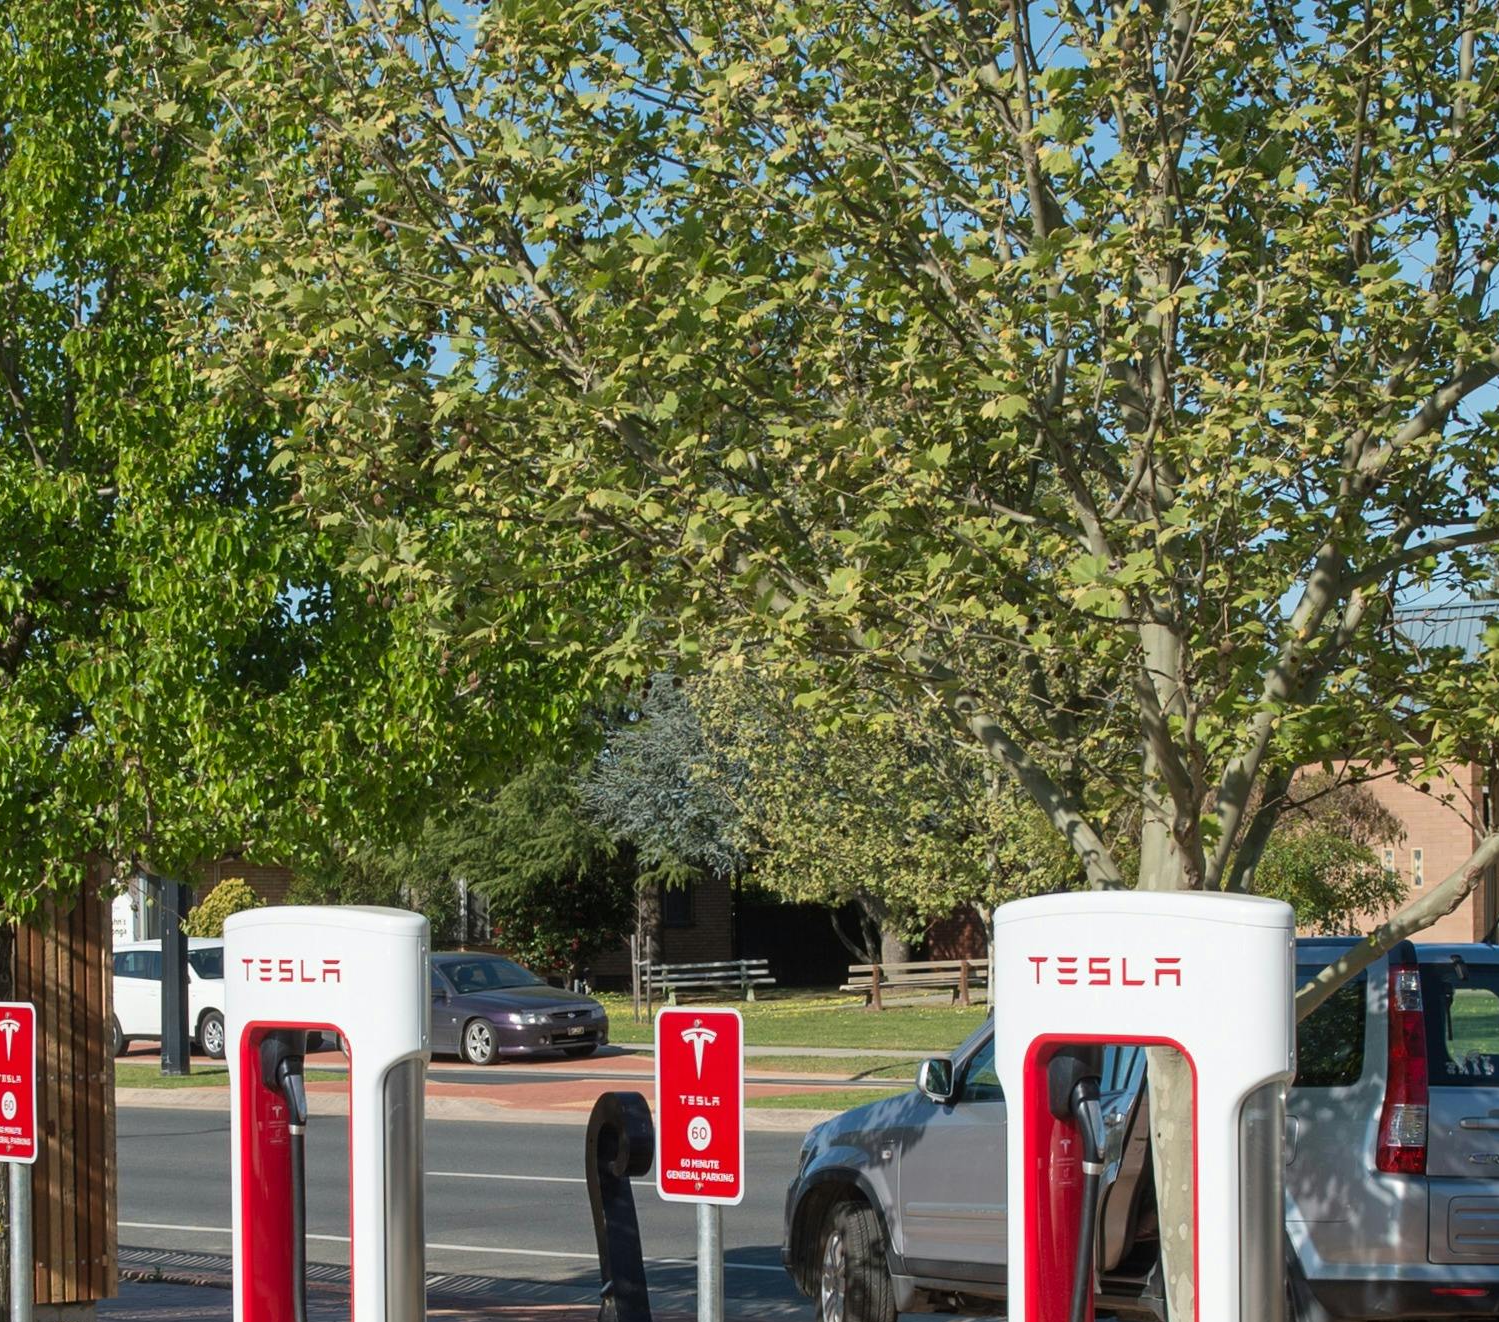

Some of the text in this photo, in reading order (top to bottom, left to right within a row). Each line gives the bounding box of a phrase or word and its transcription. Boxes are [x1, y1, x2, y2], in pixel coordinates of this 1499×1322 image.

[242, 959, 340, 982] TESLA
[1028, 957, 1181, 986] TESLA
[4, 1100, 13, 1111] 60
[679, 1095, 720, 1106] TESLA
[691, 1126, 707, 1140] 60
[10, 1136, 31, 1146] PARKING
[680, 1158, 719, 1170] 60 MINUTE
[666, 1170, 734, 1182] GENERAL PARKING
